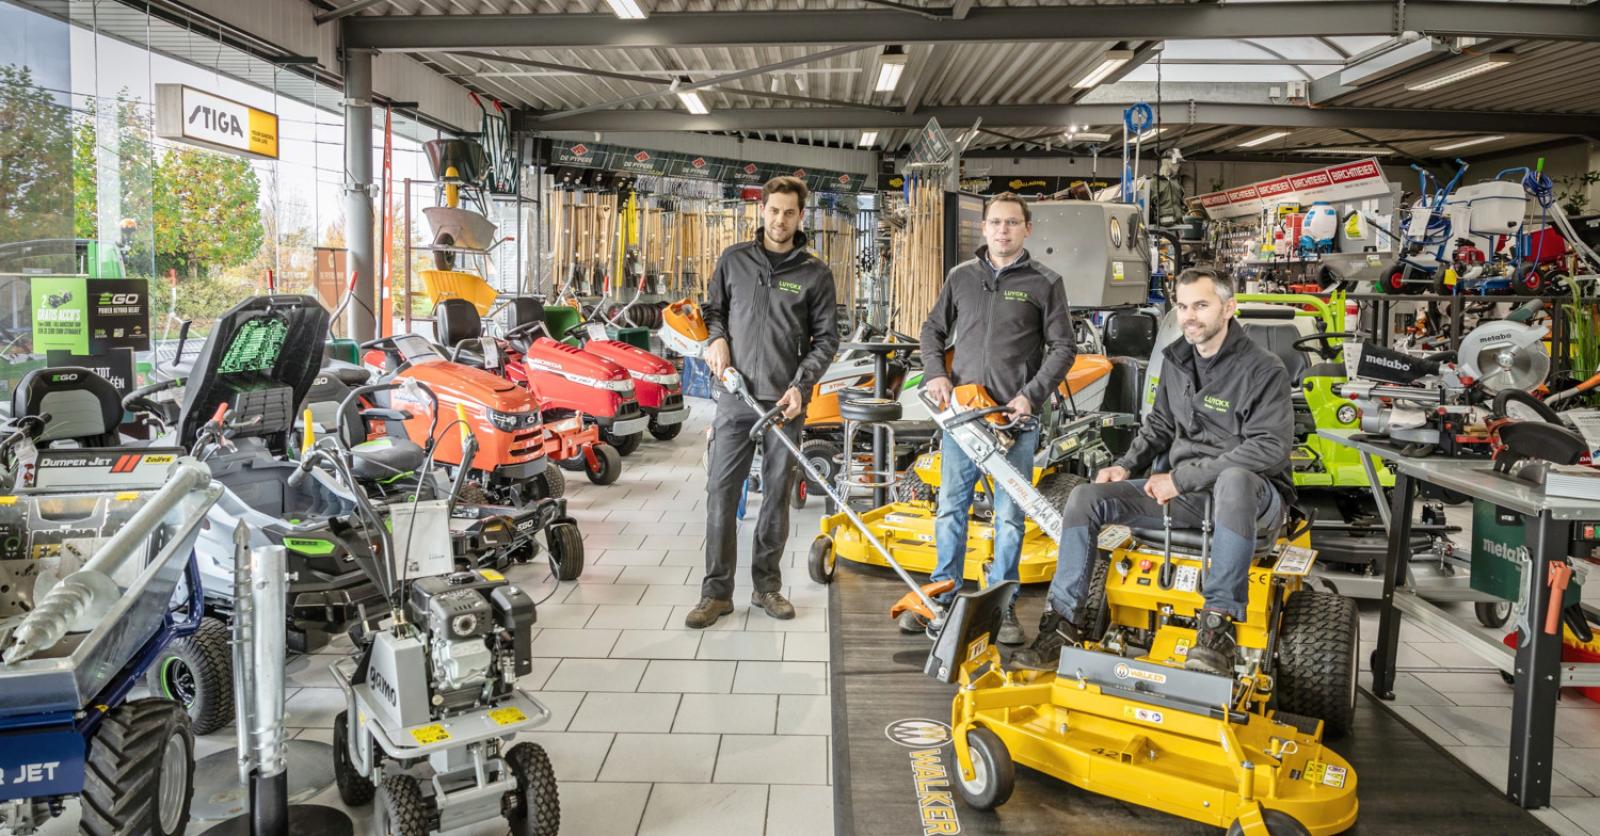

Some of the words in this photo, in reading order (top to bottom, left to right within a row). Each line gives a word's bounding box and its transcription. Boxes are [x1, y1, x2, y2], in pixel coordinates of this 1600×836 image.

[188, 105, 244, 139] STIGA
[1331, 163, 1376, 181] BIRCHMEIER
[1293, 174, 1330, 189] BIRCHMEIER
[98, 292, 139, 305] EGO
[1480, 333, 1512, 343] metabo
[1365, 353, 1410, 371] metabo
[52, 374, 78, 382] EGO
[312, 377, 328, 386] GO
[1483, 538, 1524, 563] metab
[370, 665, 397, 708] gamo
[13, 761, 61, 784] JET
[908, 748, 961, 836] WALKER
